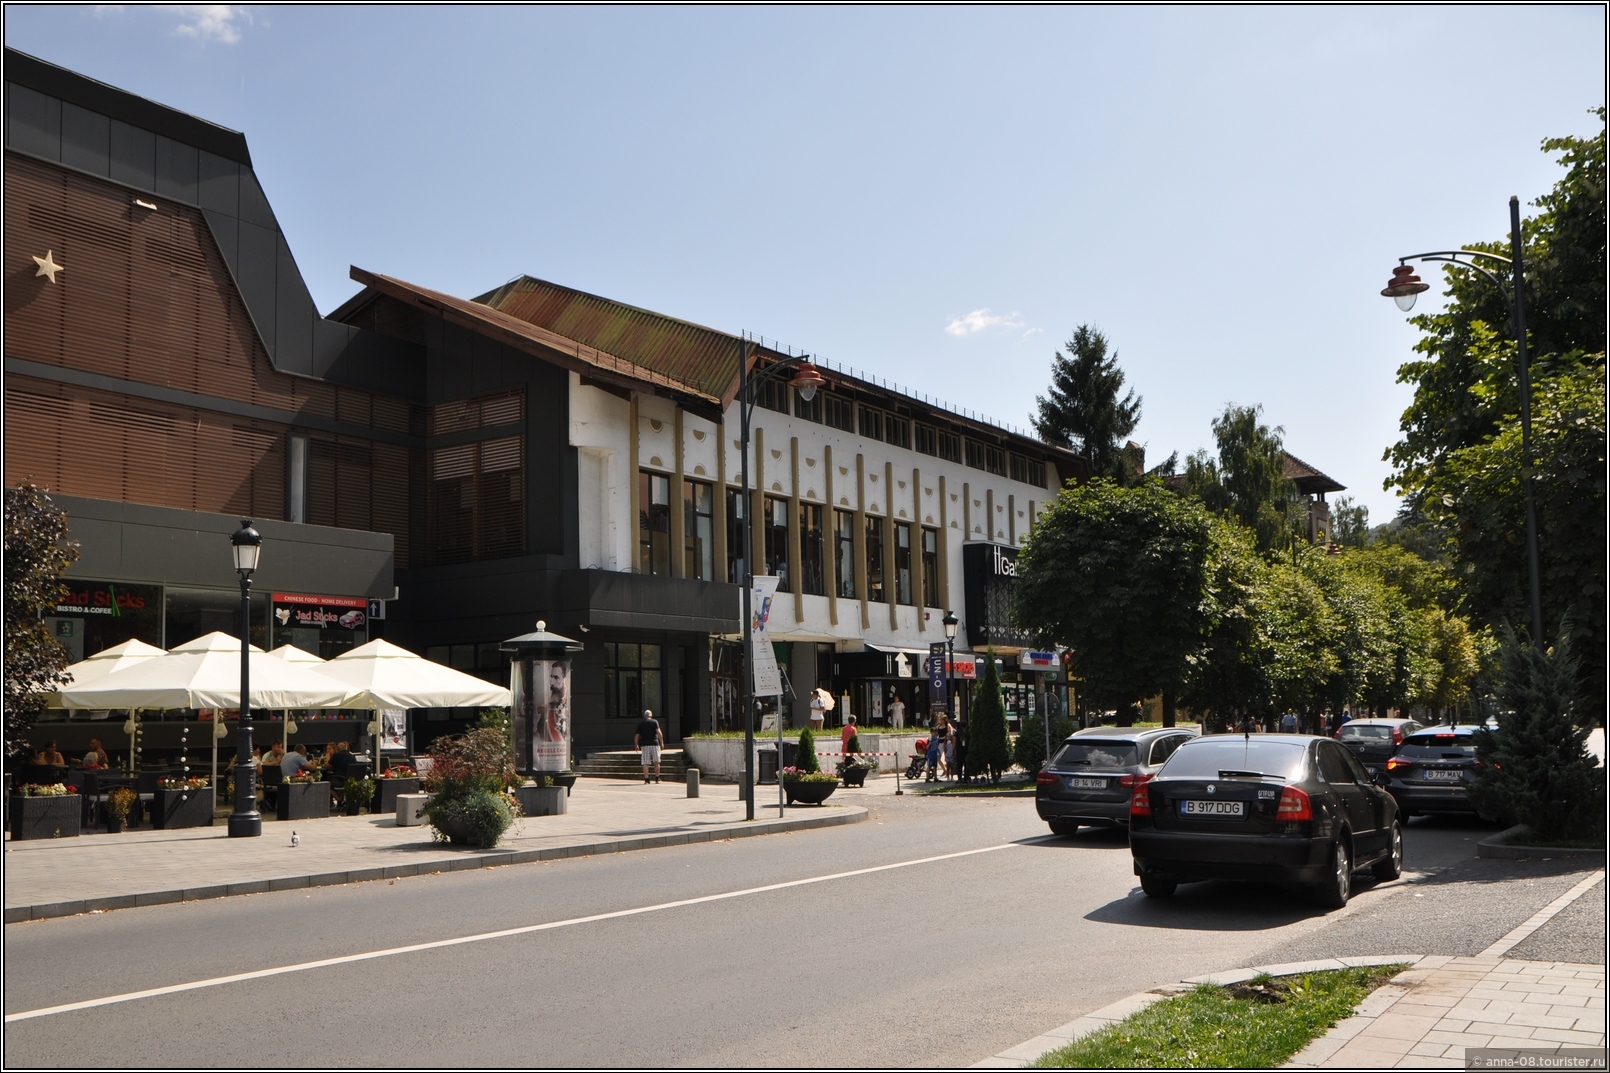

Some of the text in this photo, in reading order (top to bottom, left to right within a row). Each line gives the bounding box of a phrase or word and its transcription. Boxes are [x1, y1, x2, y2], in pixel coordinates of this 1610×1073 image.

[57, 605, 82, 613] BISTRO
[90, 607, 112, 615] COFEE
[295, 610, 312, 621] Jad
[1428, 770, 1433, 778] B
[1187, 801, 1240, 814] B 917 DDG
